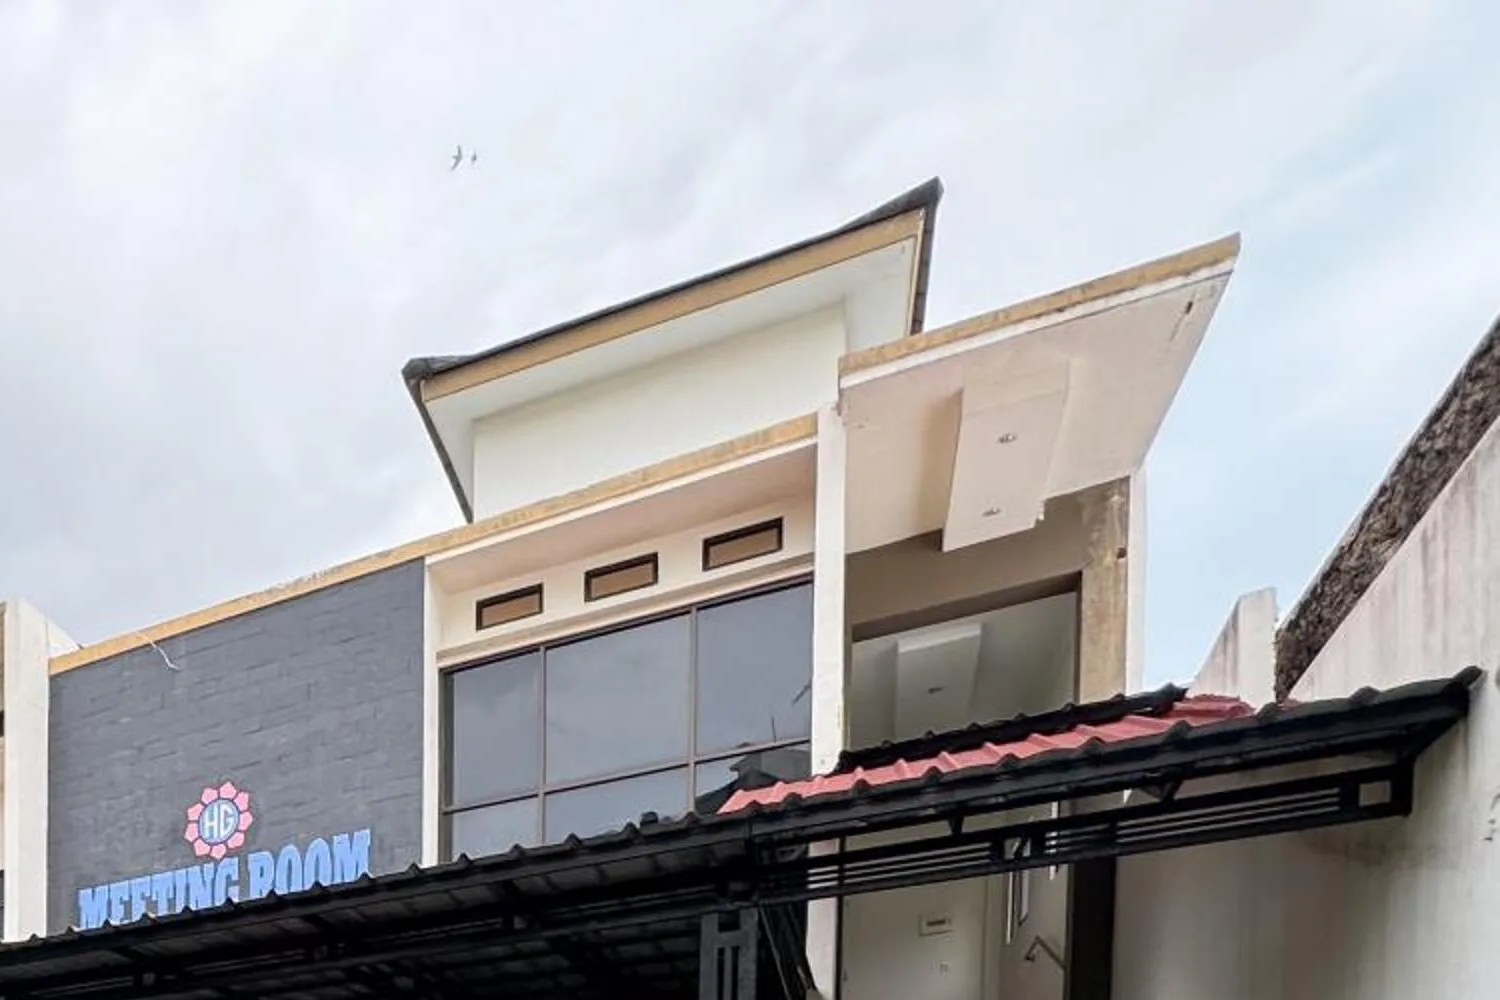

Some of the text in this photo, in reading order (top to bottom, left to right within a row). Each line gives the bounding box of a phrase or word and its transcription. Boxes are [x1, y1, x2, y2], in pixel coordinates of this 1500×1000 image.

[202, 803, 235, 840] HG
[78, 829, 371, 929] MEETING ROOM
